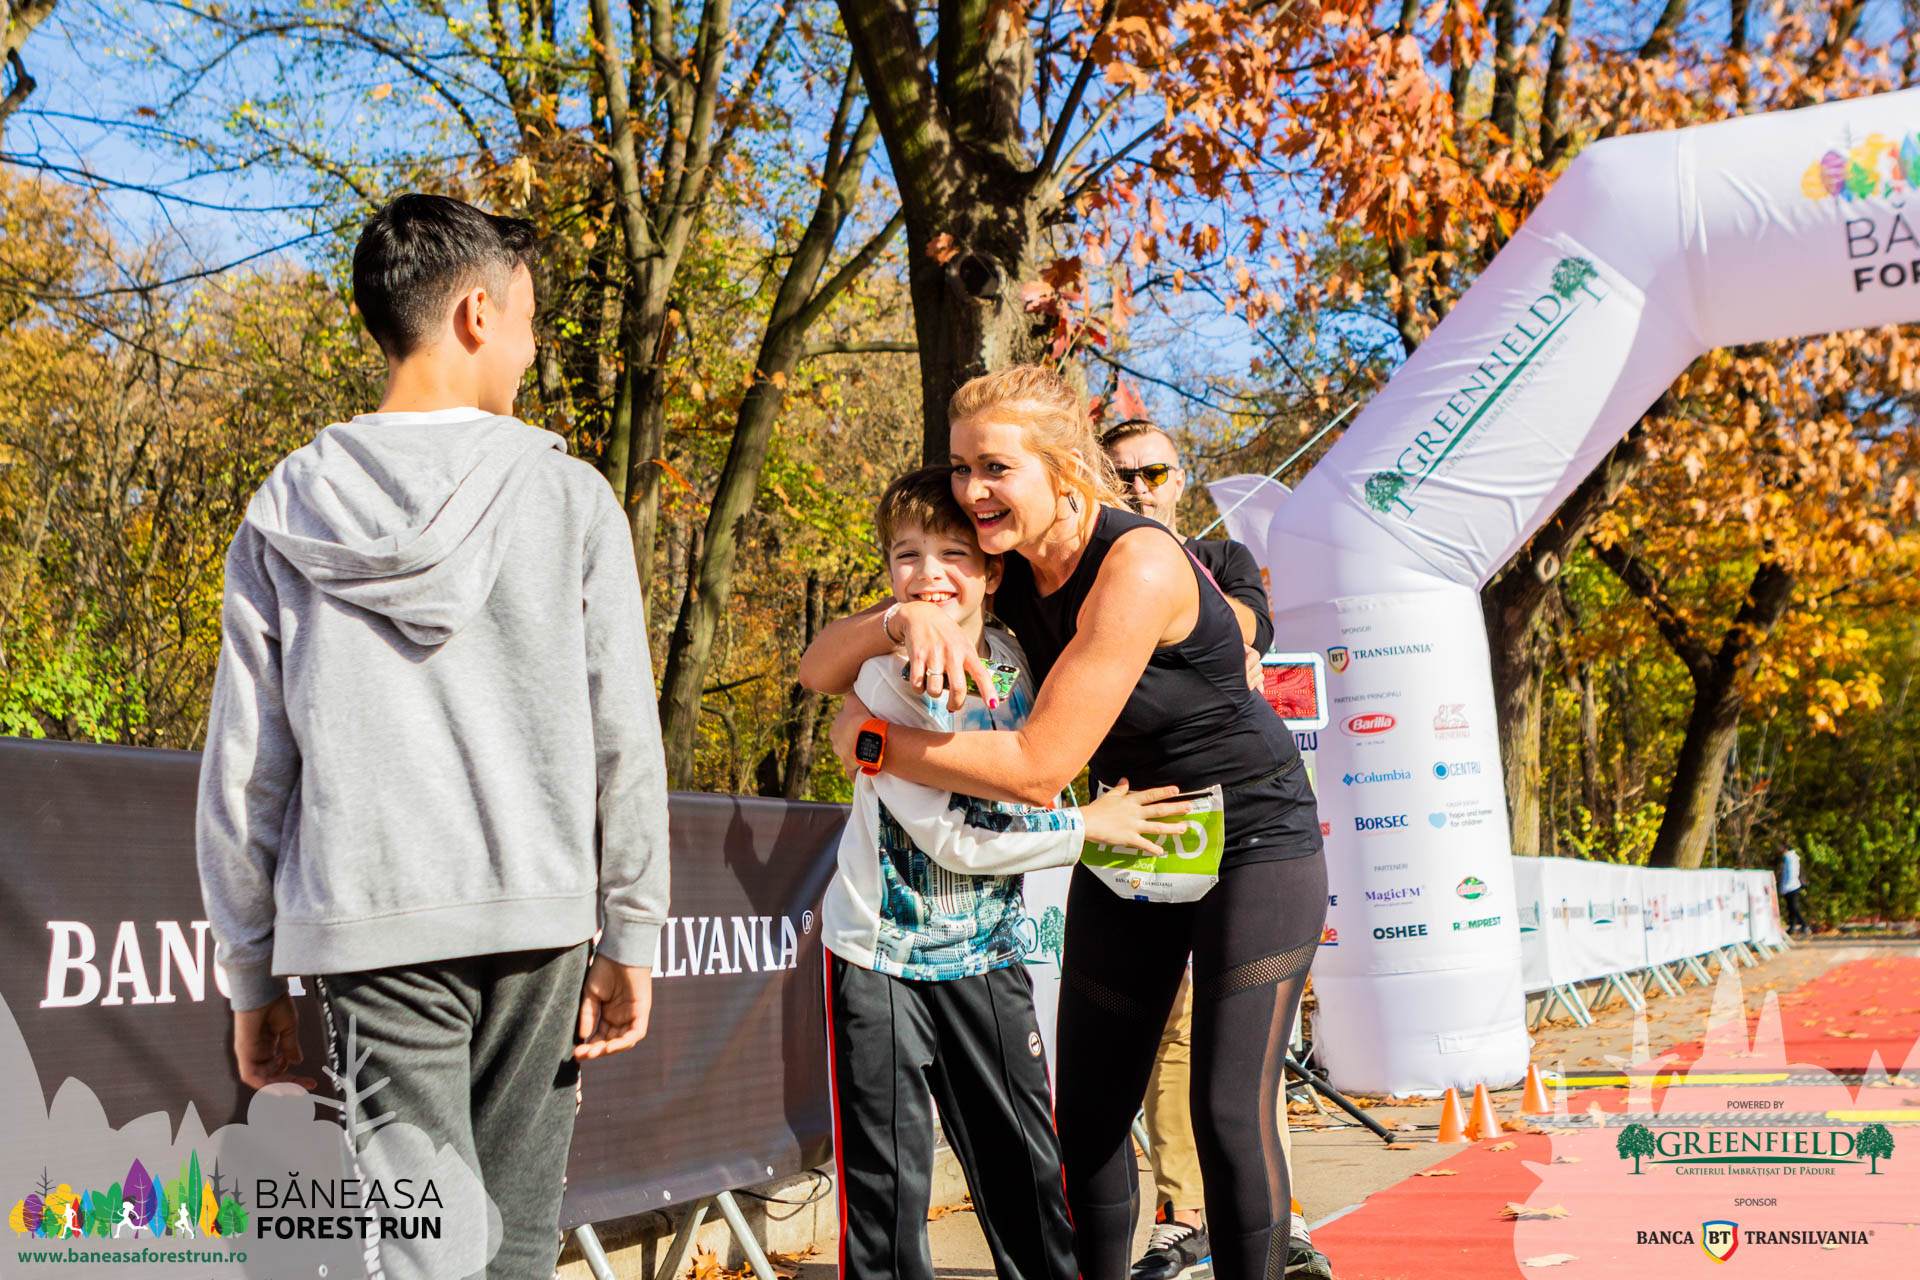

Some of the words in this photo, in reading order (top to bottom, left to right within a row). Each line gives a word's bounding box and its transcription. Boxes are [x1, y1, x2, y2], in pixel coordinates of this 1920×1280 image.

[1397, 294, 1562, 477] GREENFIELD
[1331, 651, 1345, 663] BT
[1352, 644, 1432, 660] TRANSILVANIA
[1352, 716, 1393, 731] Barilla
[1354, 768, 1412, 785] Columbia
[1355, 814, 1409, 831] BORSEC
[1373, 864, 1408, 872] PARTENERI
[1365, 886, 1421, 902] MagicFM
[1373, 924, 1428, 940] OSHEE
